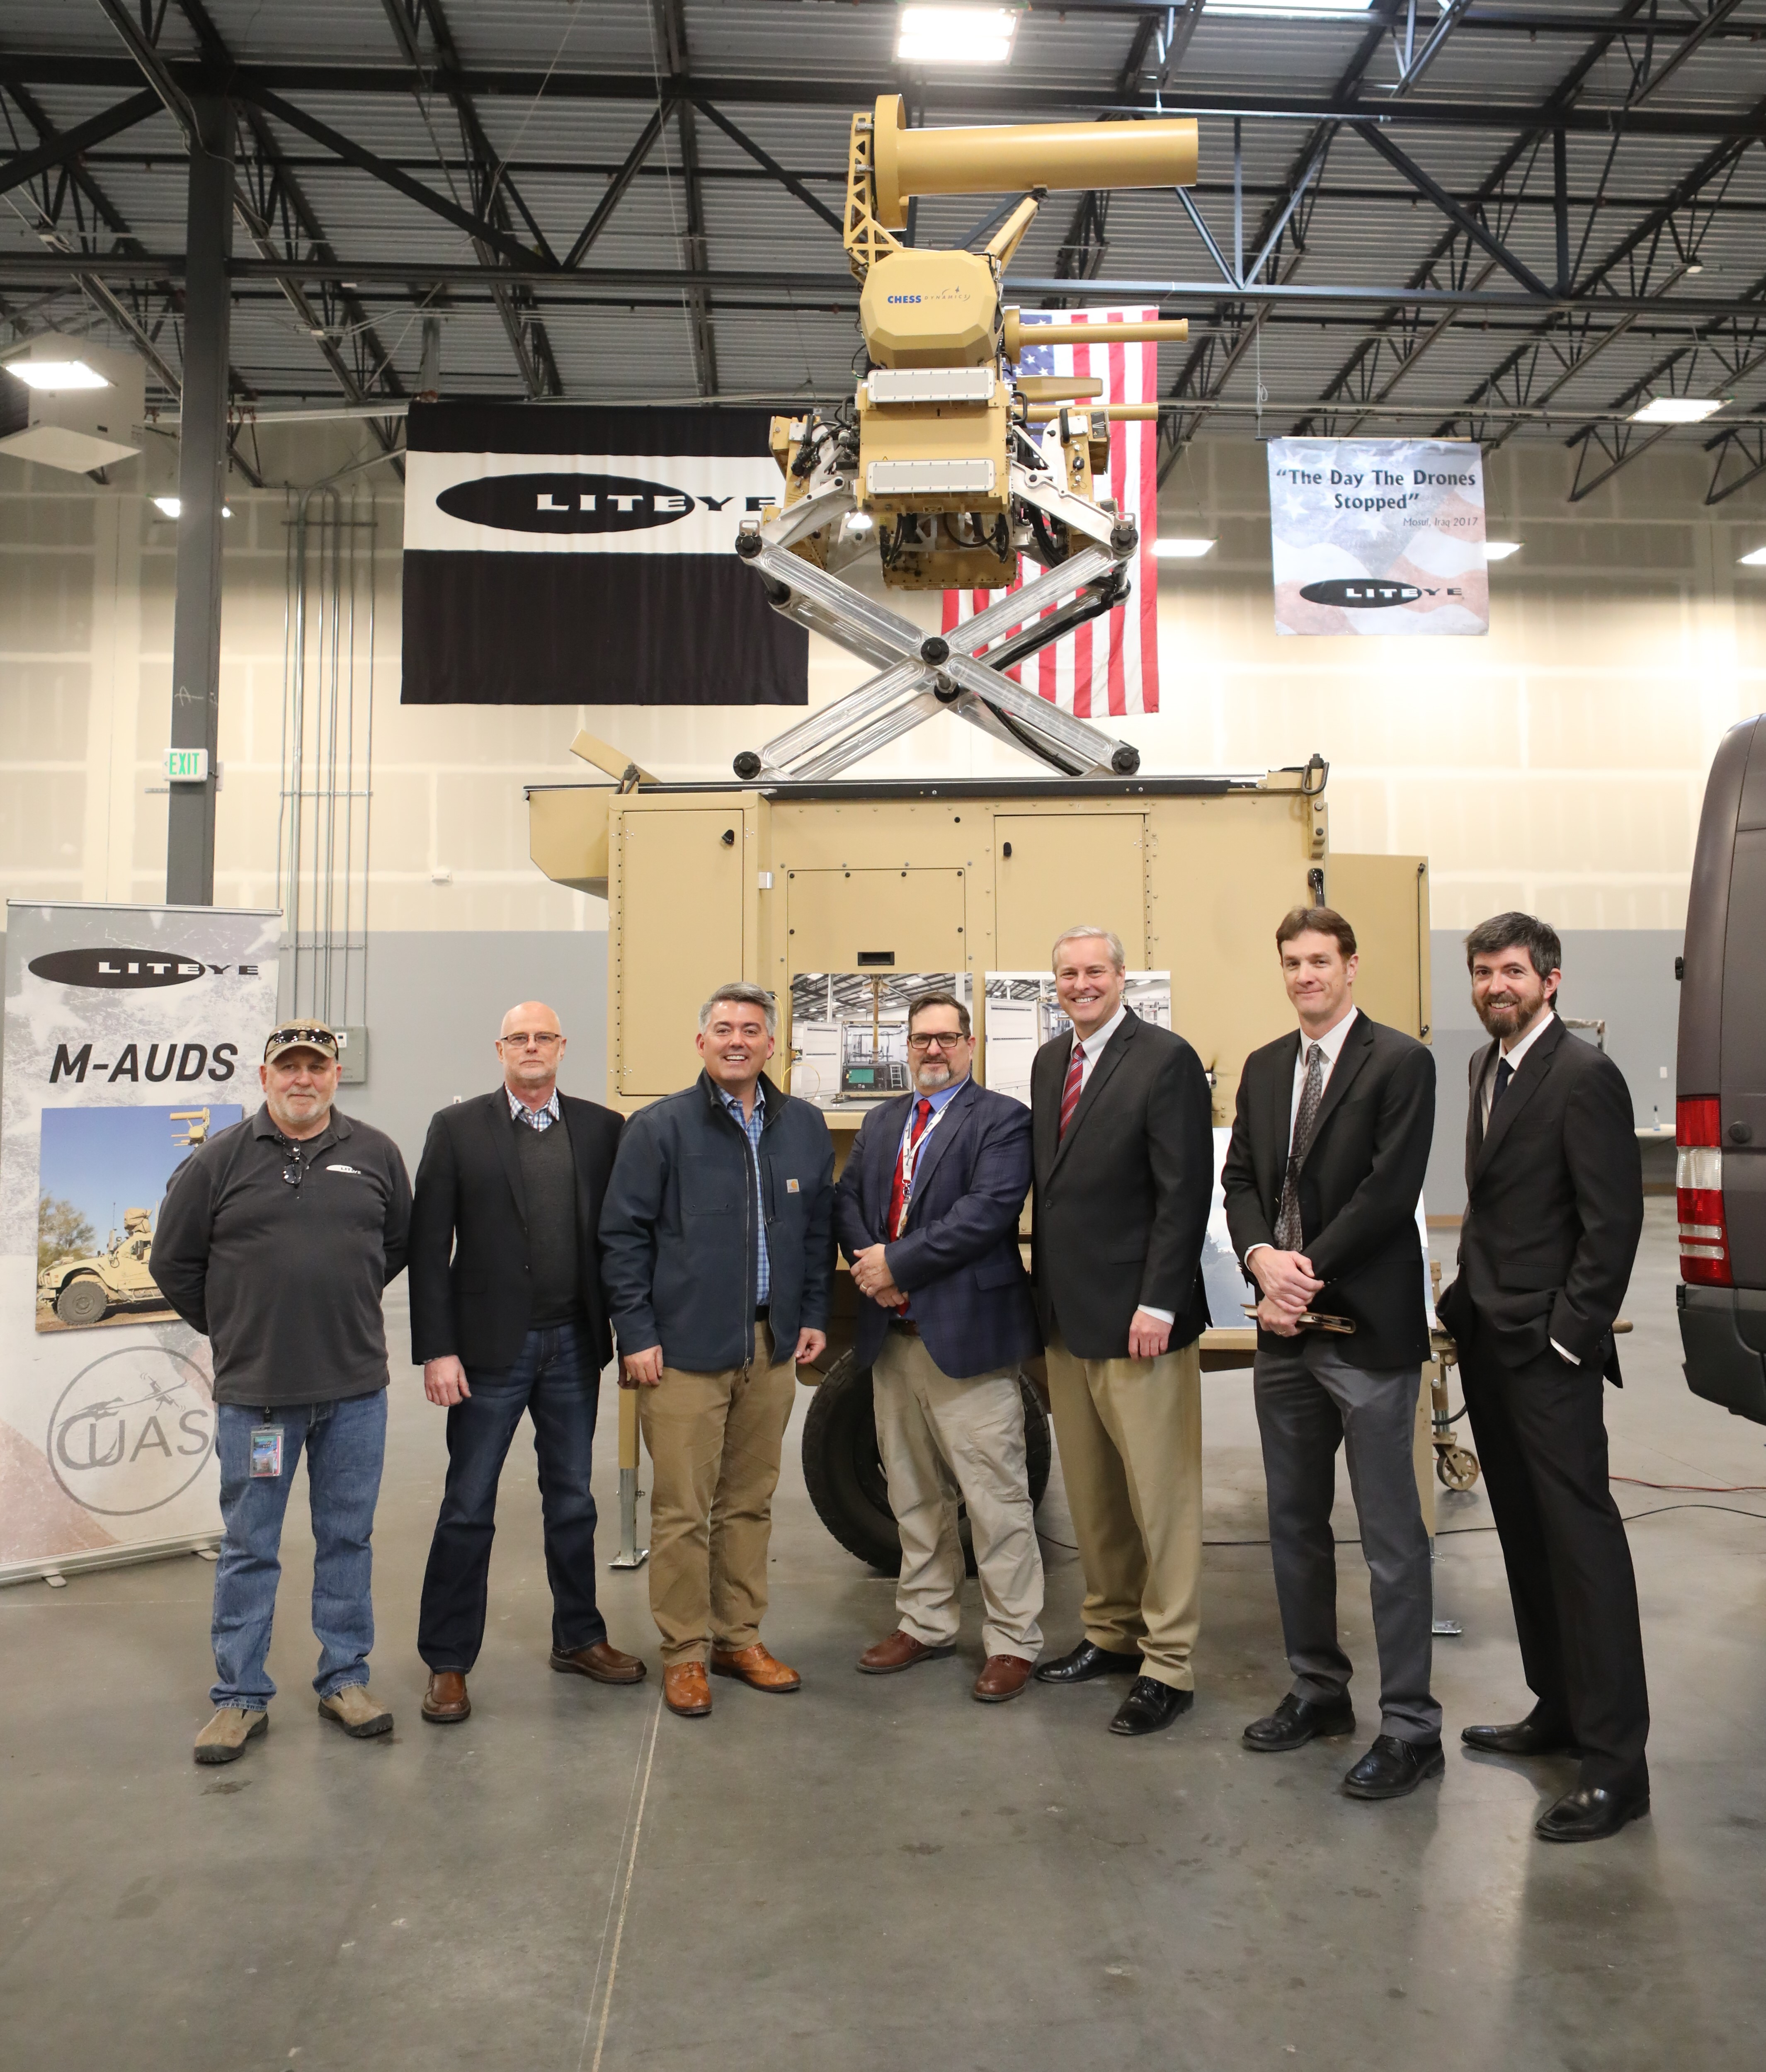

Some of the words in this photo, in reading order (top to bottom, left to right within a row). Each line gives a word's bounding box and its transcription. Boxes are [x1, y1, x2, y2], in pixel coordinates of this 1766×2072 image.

[887, 295, 922, 304] CHESS
[1276, 469, 1322, 485] “The
[1330, 470, 1364, 488] Day
[1372, 470, 1404, 485] The
[1413, 469, 1476, 485] Drones
[536, 493, 776, 512] LITEYE
[1334, 492, 1419, 512] Stopped”
[1402, 517, 1431, 527] Mosul,
[1434, 517, 1451, 528] Iraq
[1453, 517, 1479, 526] 2017
[1346, 587, 1463, 599] LITEYE
[169, 752, 200, 775] EXIT
[98, 961, 259, 976] LITEYE
[49, 1042, 238, 1083] M-AUDS
[56, 1409, 209, 1471] CUAS
